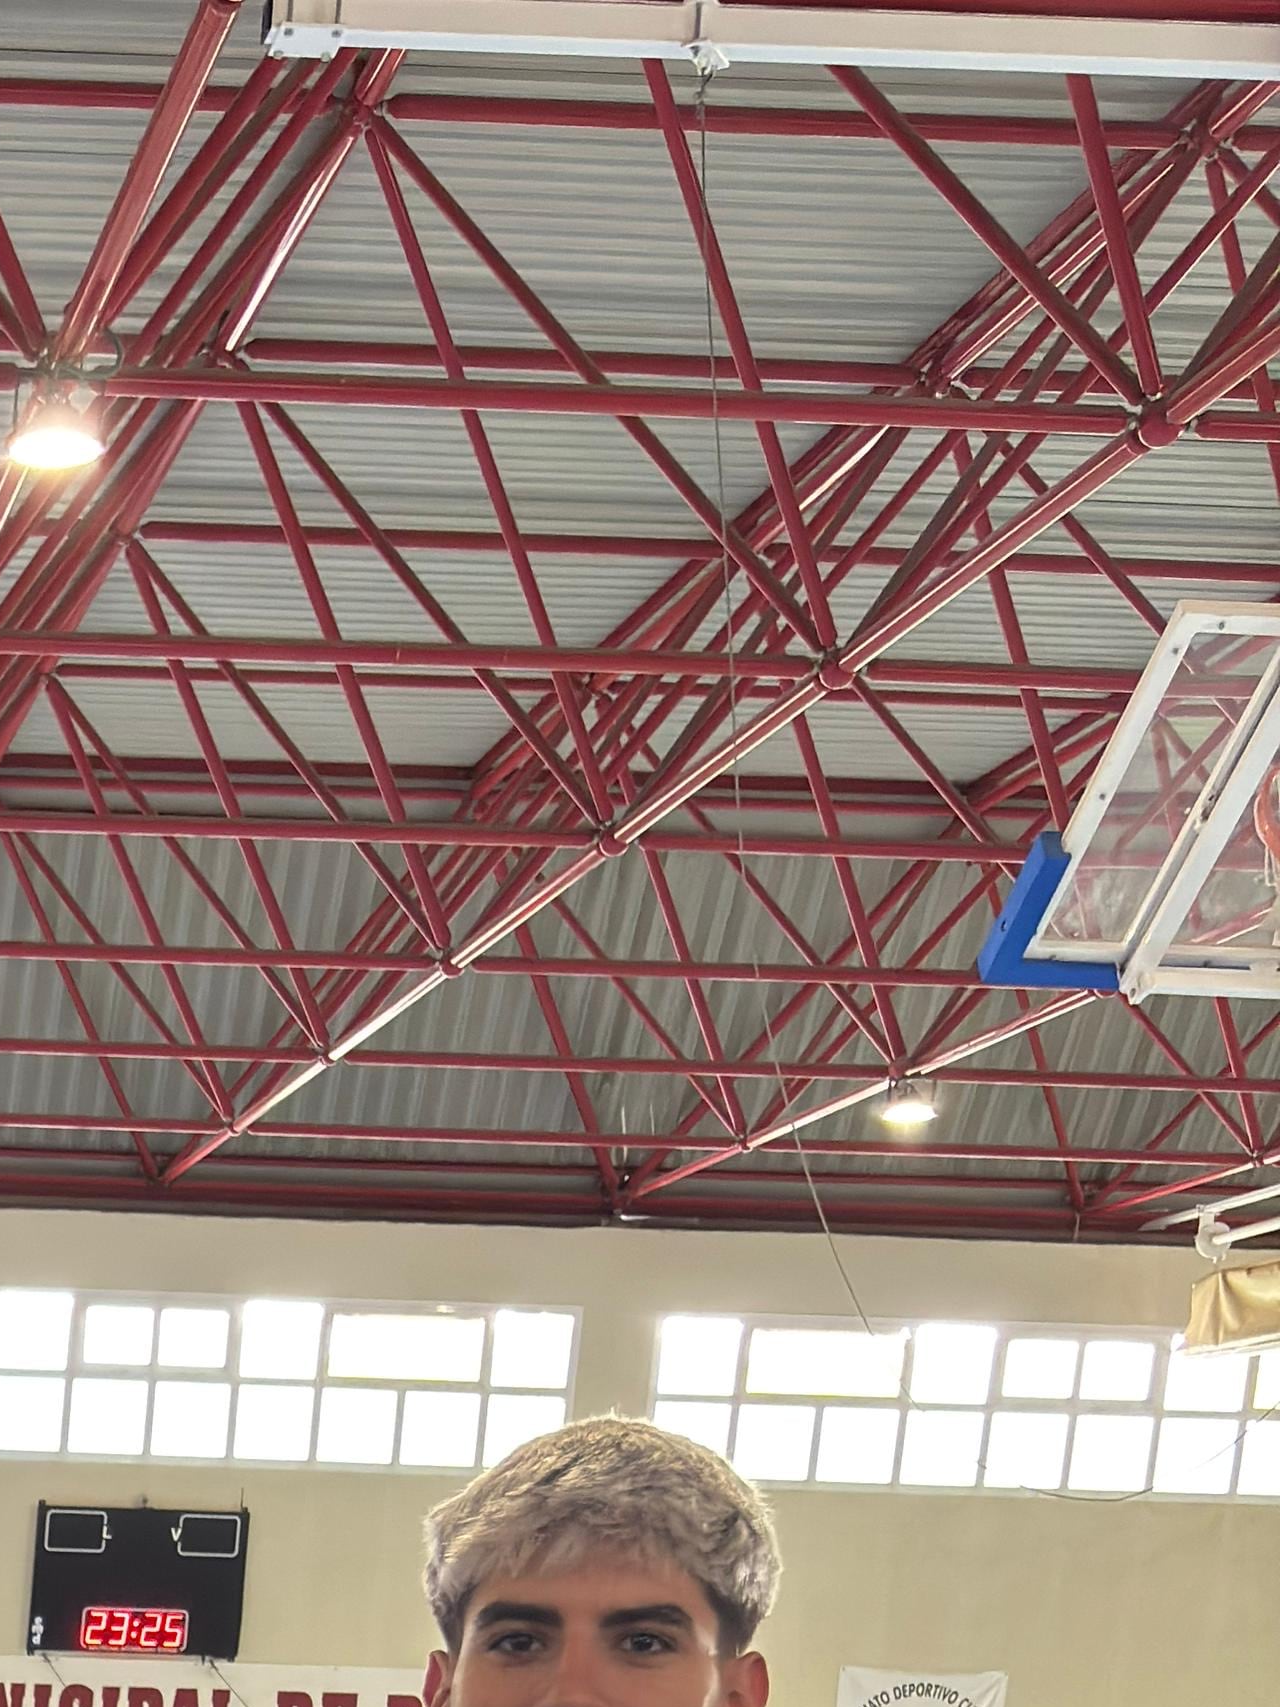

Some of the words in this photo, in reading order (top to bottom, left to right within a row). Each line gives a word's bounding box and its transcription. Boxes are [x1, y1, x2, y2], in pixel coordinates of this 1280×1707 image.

[170, 1527, 182, 1542] V
[84, 1611, 184, 1648] 23:25
[892, 1682, 960, 1706] DEPORTIVO
